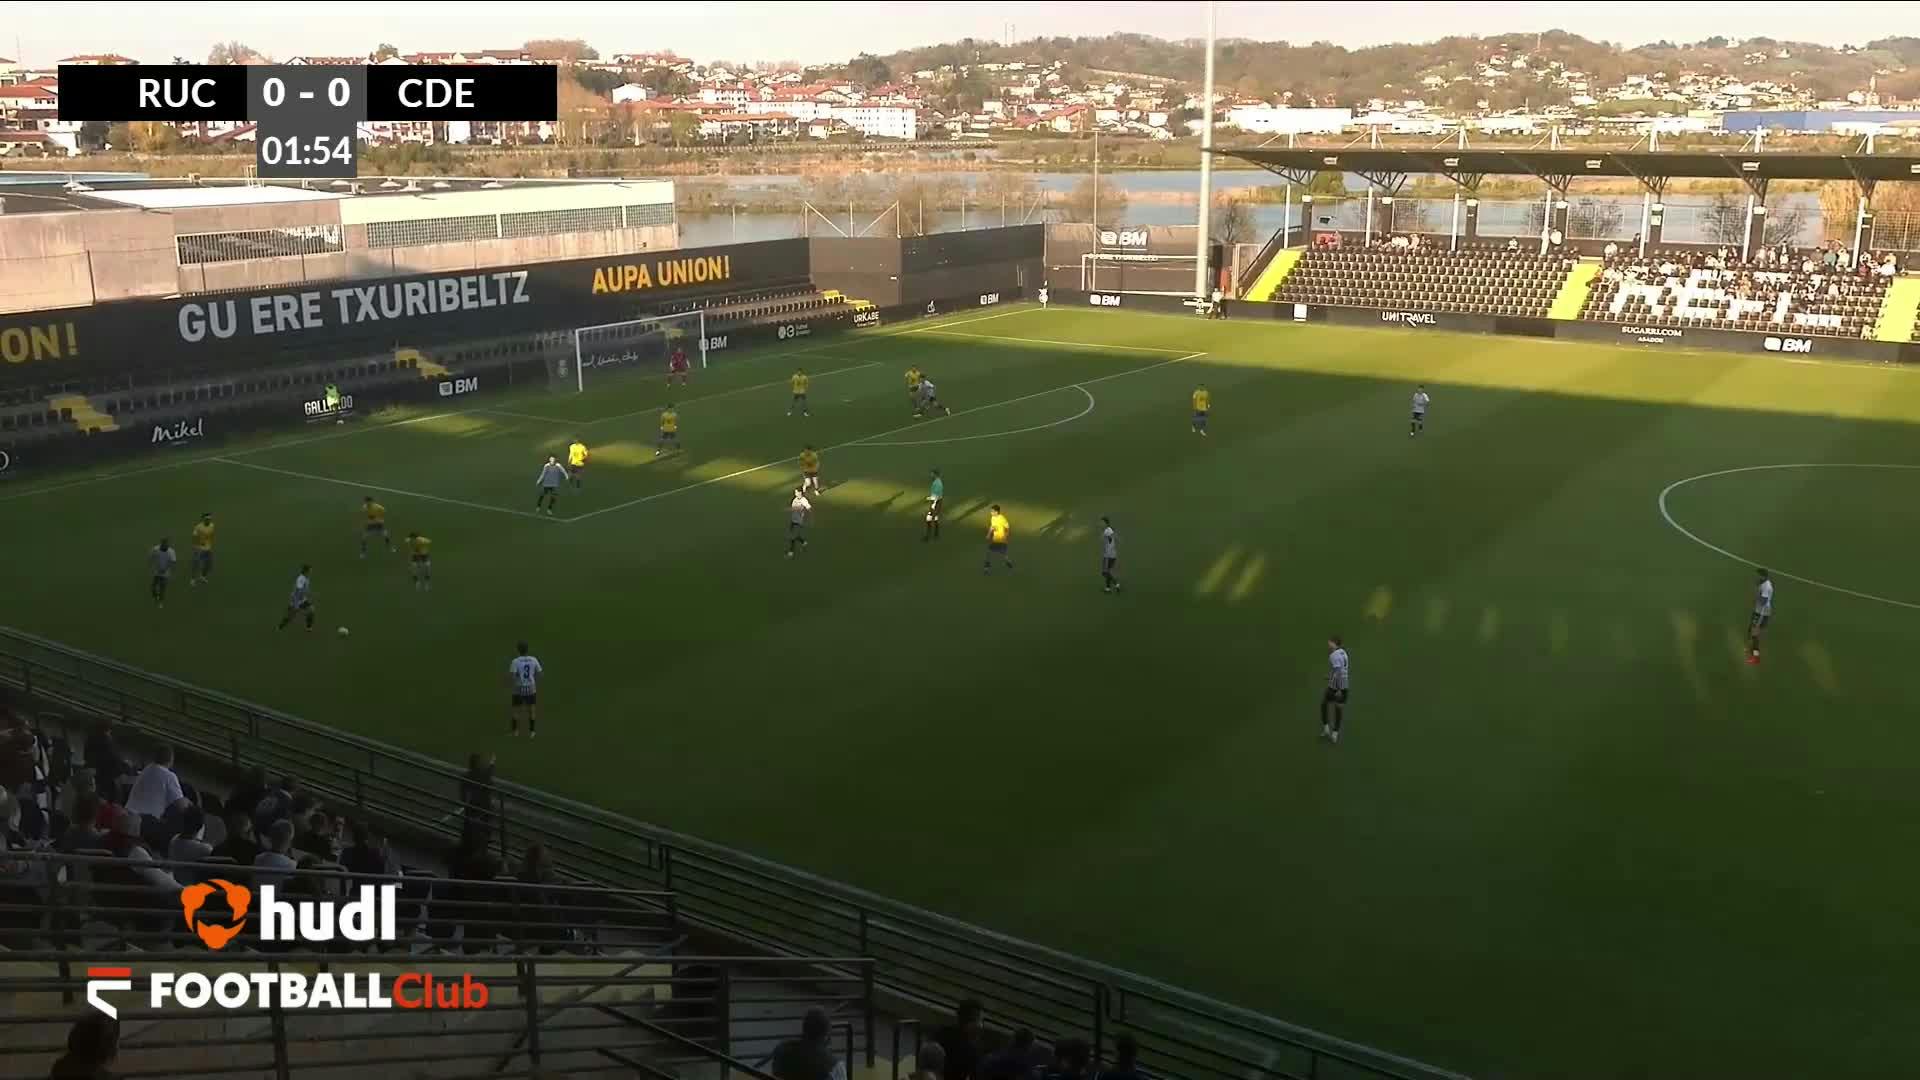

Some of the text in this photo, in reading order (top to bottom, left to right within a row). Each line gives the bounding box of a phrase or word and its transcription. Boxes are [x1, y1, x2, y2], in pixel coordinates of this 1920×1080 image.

[1119, 231, 1148, 246] BM
[591, 255, 729, 294] AUPA UNION!
[178, 270, 530, 342] GU ERE TXURIBELTZ
[1101, 295, 1121, 307] BM
[1381, 311, 1437, 327] UNITRAVEL
[709, 336, 728, 351] BM
[1785, 339, 1811, 353] BM
[455, 376, 479, 395] BM
[151, 418, 204, 444] Mikel
[523, 663, 530, 678] 3
